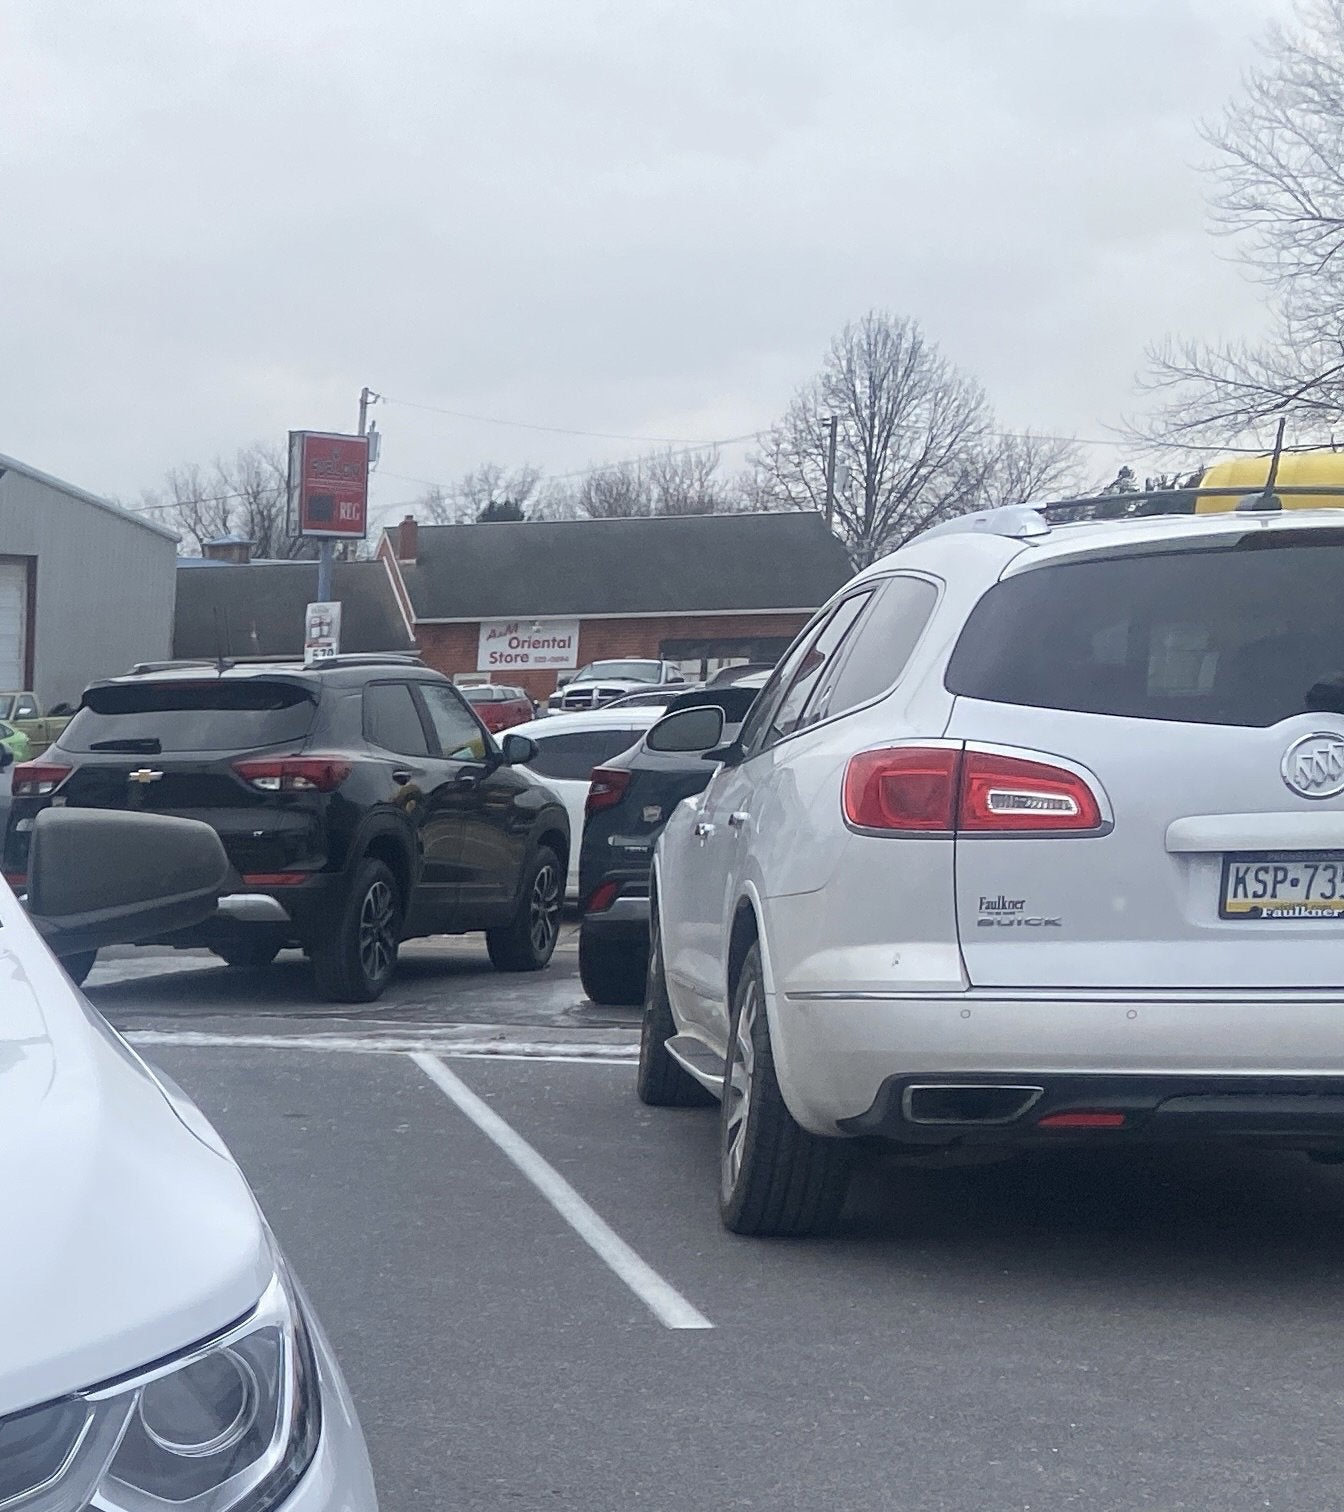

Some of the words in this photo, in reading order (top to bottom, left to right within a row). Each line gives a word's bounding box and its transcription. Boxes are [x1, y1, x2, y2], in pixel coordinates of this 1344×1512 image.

[339, 502, 361, 520] REG
[508, 635, 572, 649] Oriental
[489, 651, 529, 664] Store
[978, 896, 1026, 910] Faulkner
[1260, 906, 1343, 918] Faulkner
[977, 917, 1062, 927] BUICK
